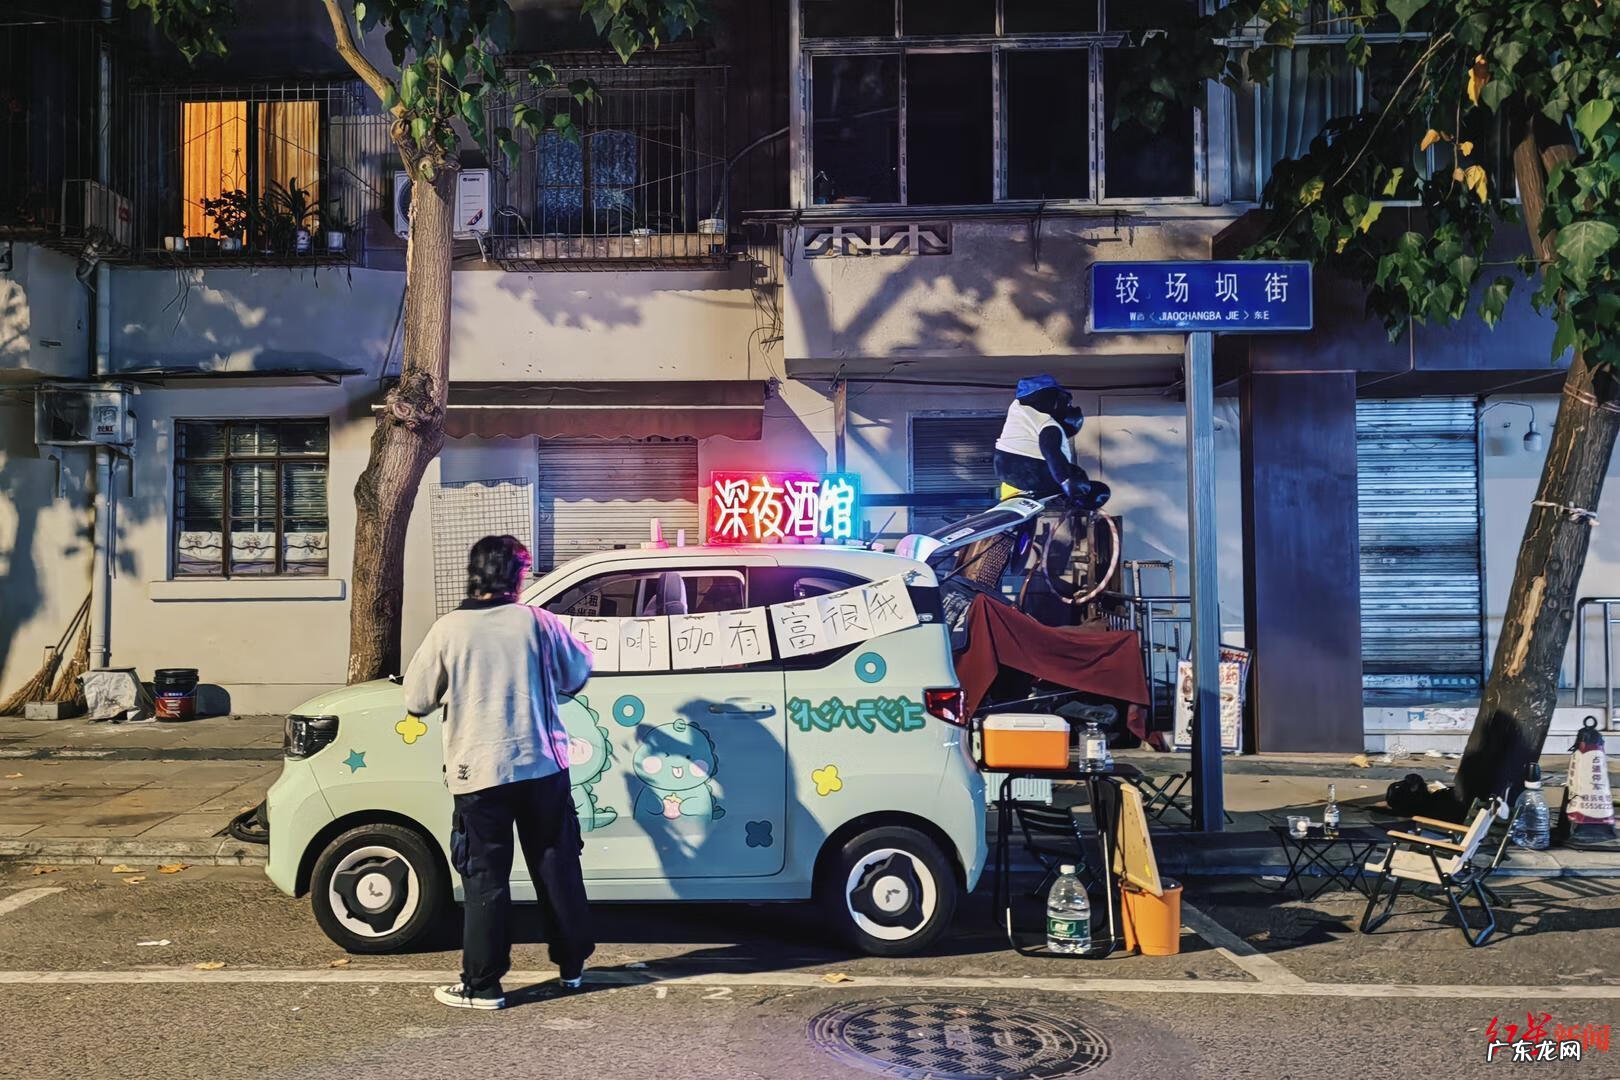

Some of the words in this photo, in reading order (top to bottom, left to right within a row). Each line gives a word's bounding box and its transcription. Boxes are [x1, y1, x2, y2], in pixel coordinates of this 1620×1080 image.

[1115, 272, 1289, 304] 较场坝街
[1159, 311, 1222, 321] JIAOCHANGBA
[1225, 311, 1240, 321] JIE
[714, 476, 855, 539] 深夜酒馆
